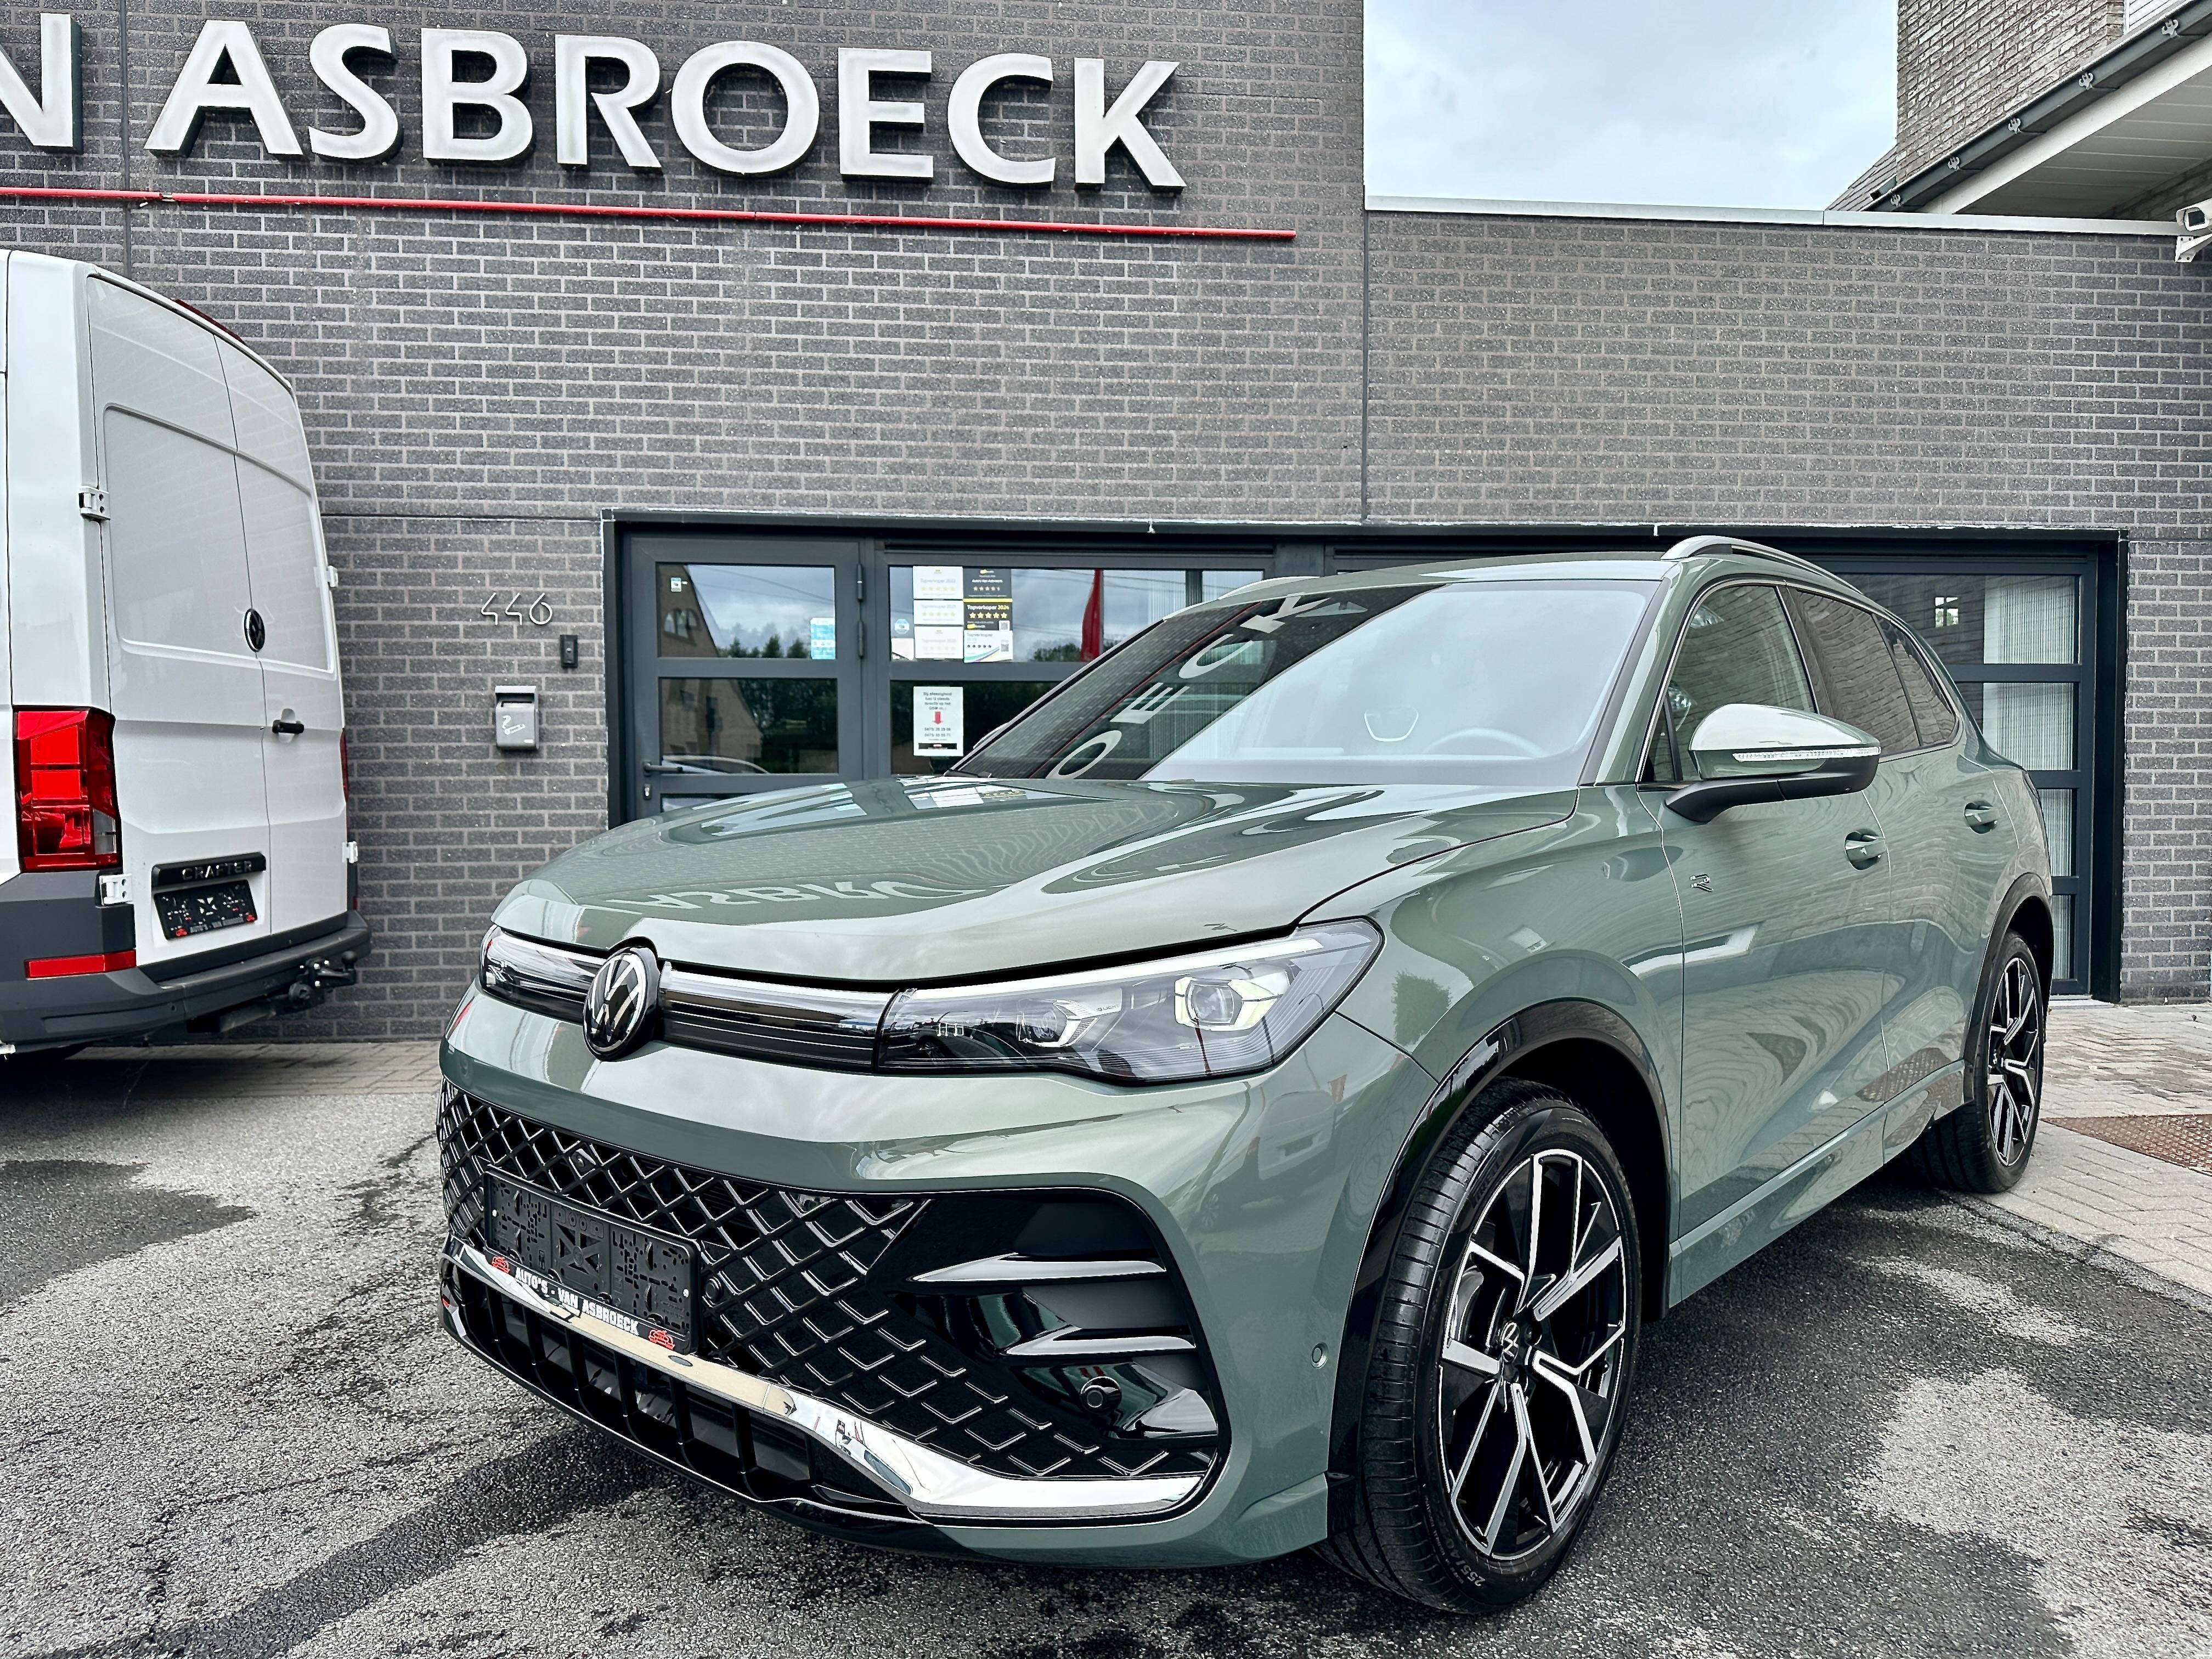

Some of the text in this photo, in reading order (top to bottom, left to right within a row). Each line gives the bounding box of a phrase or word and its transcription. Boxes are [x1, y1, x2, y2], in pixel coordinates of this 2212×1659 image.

[144, 20, 1187, 192] ASBROECK
[480, 591, 553, 626] 446
[182, 860, 253, 881] CRAFTER
[515, 1267, 549, 1295] AUTO'S
[557, 1287, 579, 1309] VAN
[581, 1301, 640, 1336] ASBROECK
